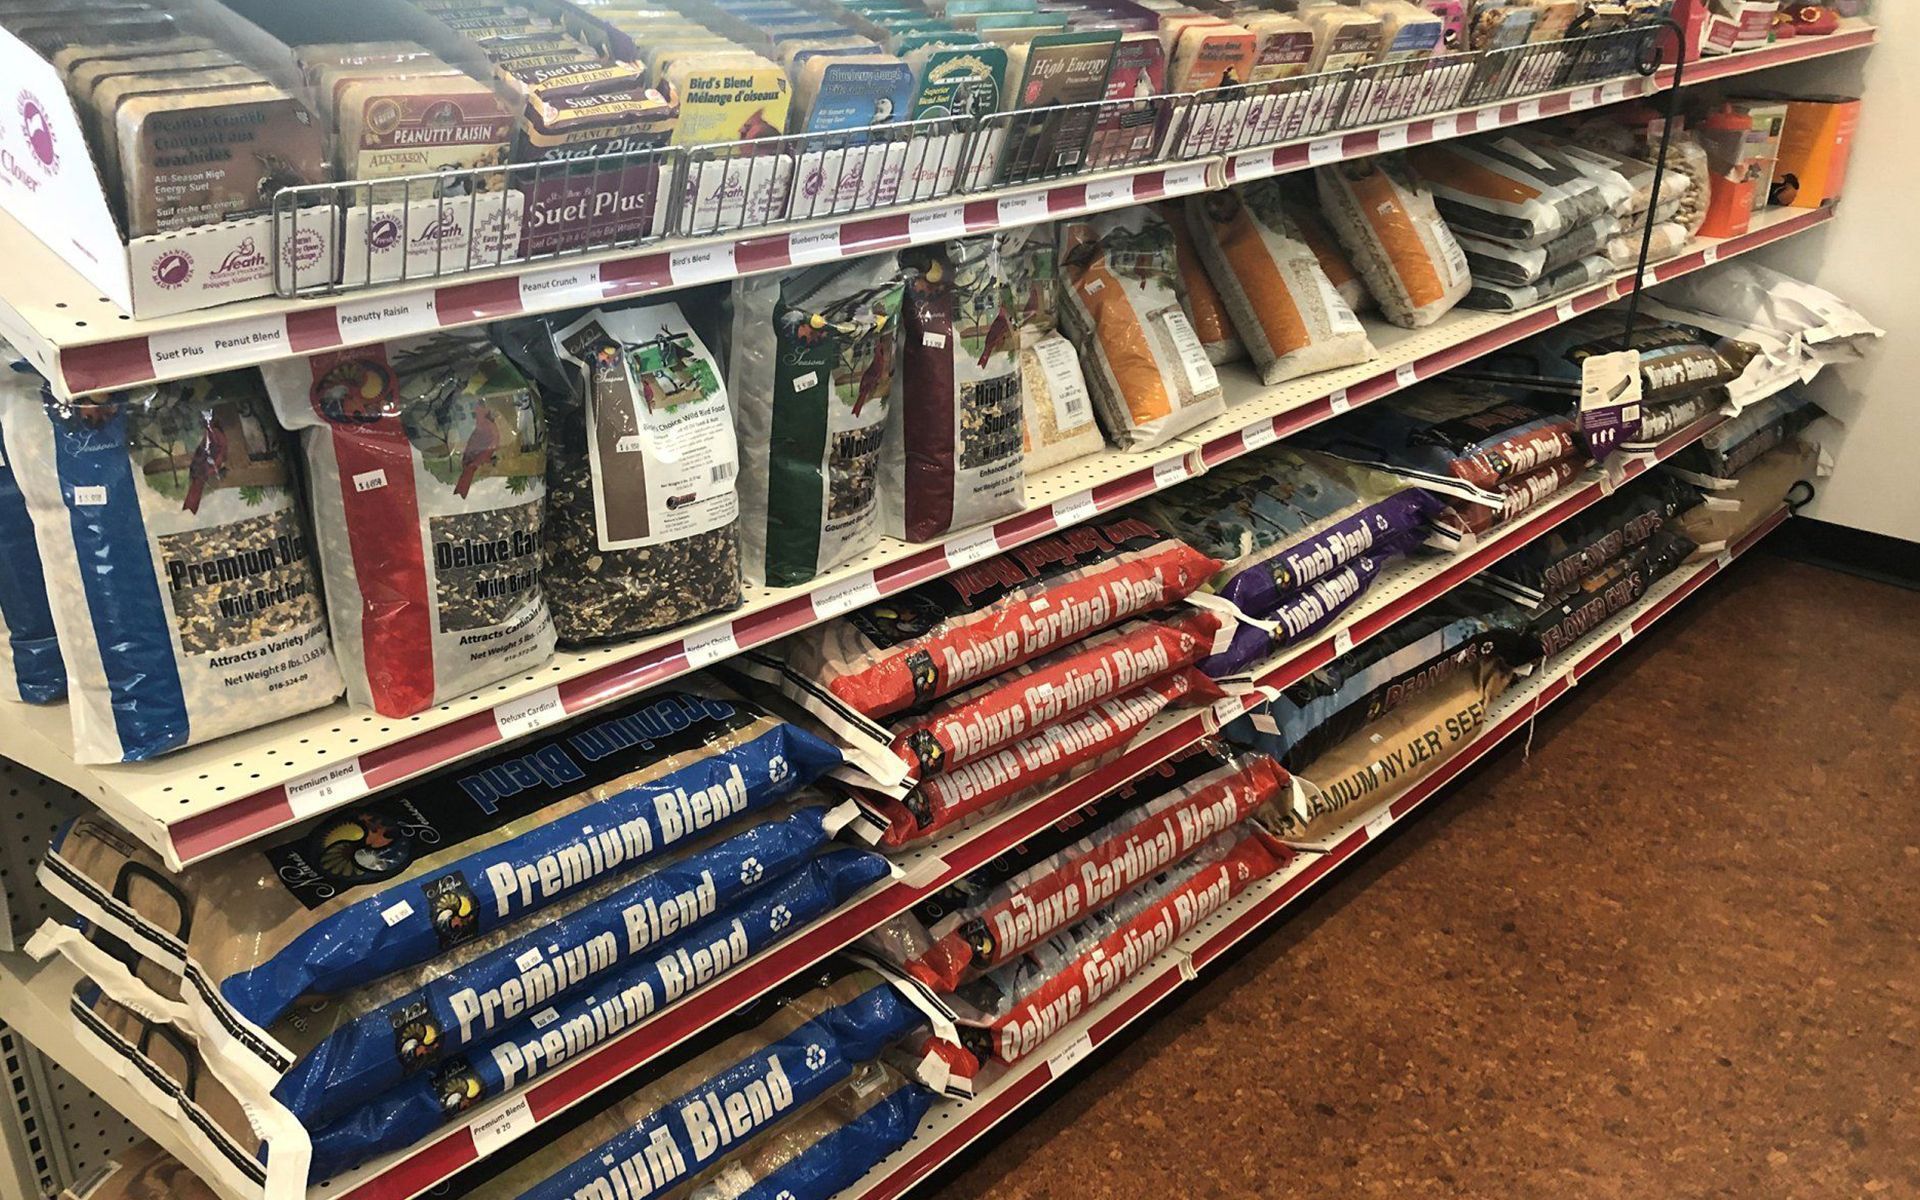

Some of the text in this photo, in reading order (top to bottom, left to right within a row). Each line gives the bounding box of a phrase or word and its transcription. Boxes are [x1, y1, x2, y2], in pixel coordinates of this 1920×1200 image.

[535, 61, 602, 80] Suet Plus
[542, 71, 613, 88] PEANUT BLEND
[689, 75, 754, 90] Bird's Blend
[1032, 58, 1065, 79] High
[1066, 57, 1108, 78] Energy
[565, 92, 632, 108] Suet Plus
[573, 106, 611, 117] PEANUT
[687, 90, 779, 105] Mélange d'oiseaux
[393, 124, 492, 144] PEANUTTY RAISIN
[566, 128, 614, 142] PEANUT
[154, 182, 210, 195] Energy Suet
[205, 169, 226, 181] High
[528, 198, 588, 228] Suet
[593, 191, 645, 217] Plus
[910, 211, 947, 225] Superior Blend
[791, 231, 839, 246] Blueberry Dough
[210, 247, 267, 276] Heath
[672, 256, 690, 267] Bird's
[691, 253, 711, 264] Blend
[523, 273, 597, 293] Peanut Crunch H
[341, 310, 381, 325] Peanutty
[383, 305, 409, 317] Raisin
[155, 330, 281, 361] Suet Plus Peanut Blend
[682, 411, 699, 424] Wild
[437, 539, 509, 570] Deluxe
[1287, 519, 1373, 587] Finch Blend
[168, 548, 277, 590] Premium
[476, 571, 532, 599] Wild Bird
[219, 586, 284, 619] Wild Bird
[1277, 565, 1359, 638] Finch Blend
[459, 631, 504, 646] Attracts
[943, 566, 1164, 688] Deluxe Cardinal Blend
[209, 650, 258, 669] Attracts
[260, 647, 267, 657] a
[267, 636, 304, 654] Variety
[470, 651, 487, 662] Net
[487, 640, 517, 658] Weight
[224, 675, 243, 687] Net
[244, 666, 280, 682] Weight
[280, 662, 287, 672] 8
[287, 658, 303, 669] lbs.
[500, 700, 557, 726] Deluxe Cardinal
[945, 635, 1169, 763] Deluxe Cardinal Blend
[457, 694, 736, 815] Premium Blend
[933, 687, 1169, 808] Deluxe Cardinal Blend
[1379, 700, 1486, 782] NYJER SEE
[289, 764, 354, 795] Premium Blend
[486, 764, 748, 917] Premium Blend
[994, 787, 1239, 955] Deluxe Cardinal Blend
[448, 884, 716, 1043] Premium Blend
[1001, 865, 1231, 1064] Deluxe Cardinal Blend
[490, 918, 749, 1091] Premium Blend
[474, 1101, 526, 1136] Premium Blend
[680, 1054, 793, 1162] Blend
[502, 1122, 512, 1131] 20
